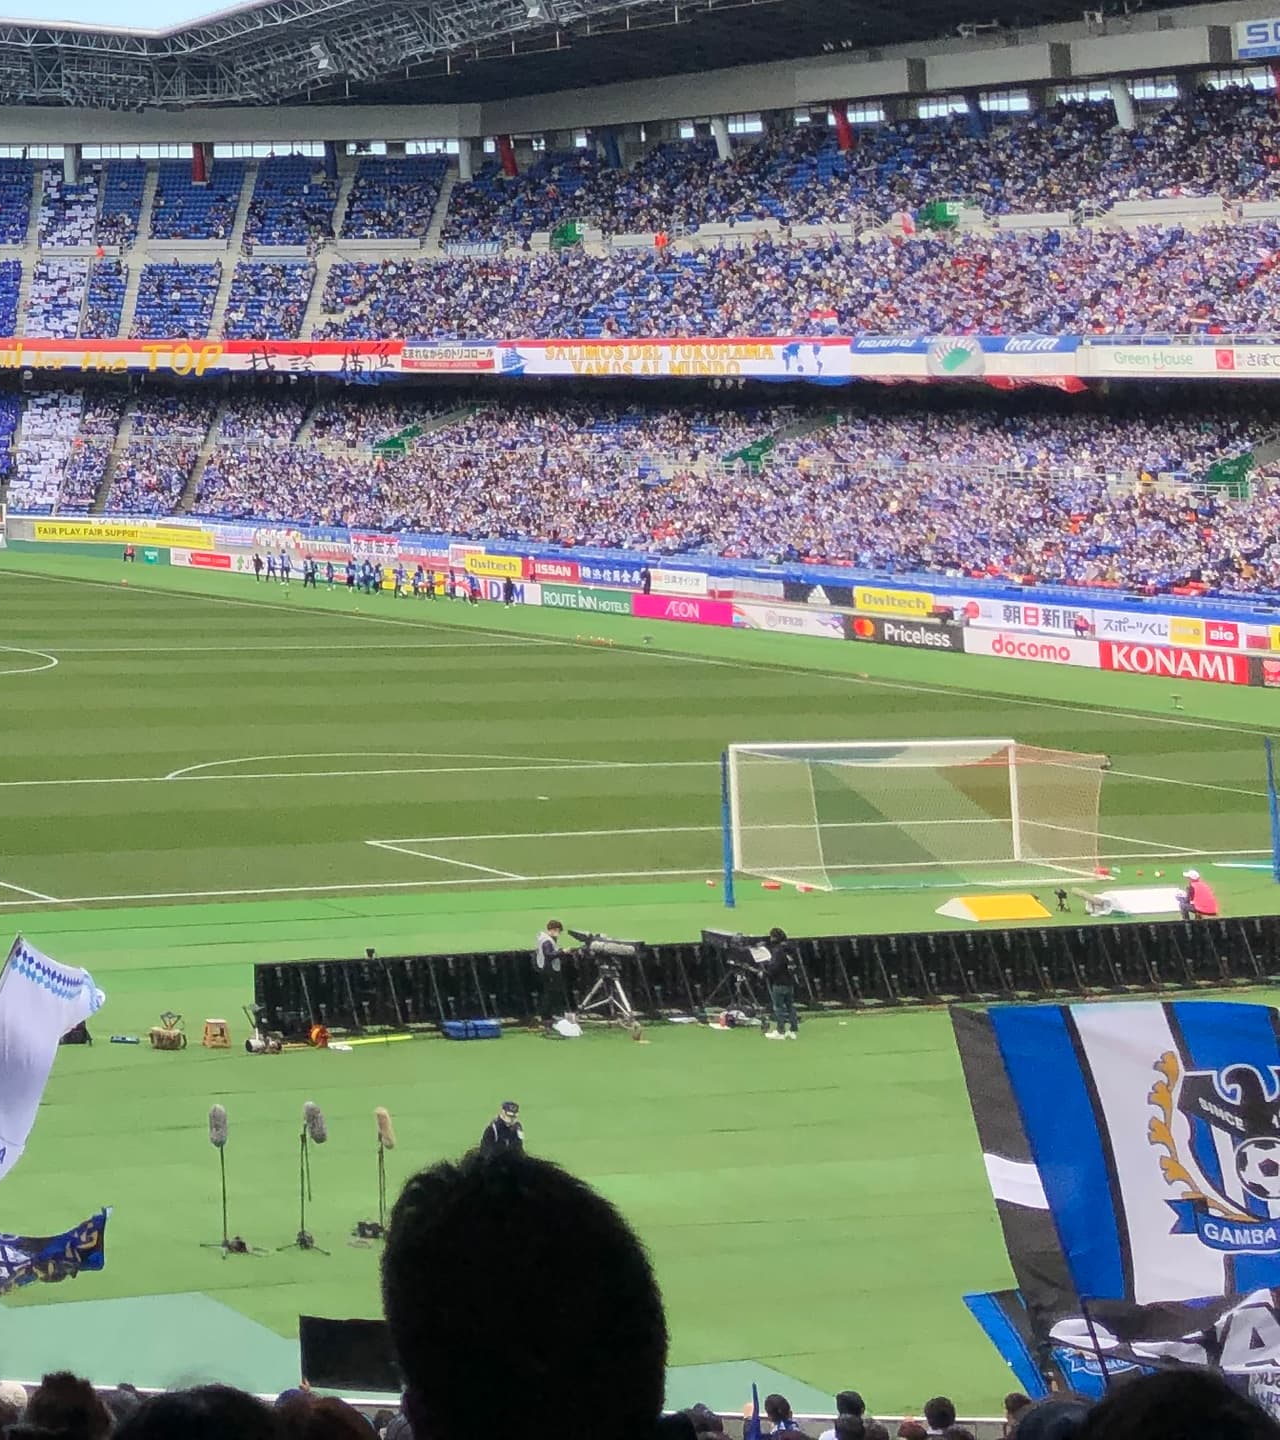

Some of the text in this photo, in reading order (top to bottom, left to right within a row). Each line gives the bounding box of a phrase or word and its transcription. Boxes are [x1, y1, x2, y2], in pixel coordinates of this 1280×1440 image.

[141, 343, 225, 376] TOP
[37, 526, 58, 536] FAIR
[470, 558, 517, 572] Owltech
[543, 591, 577, 608] ROUTE
[598, 601, 630, 613] HOTELS
[862, 592, 927, 610] Owltech
[1103, 617, 1169, 637] スポーツくじ
[992, 634, 1071, 661] docomo
[1110, 644, 1236, 682] KONAMI
[1198, 1097, 1246, 1132] SINCE
[1203, 1222, 1278, 1246] GAMBA
